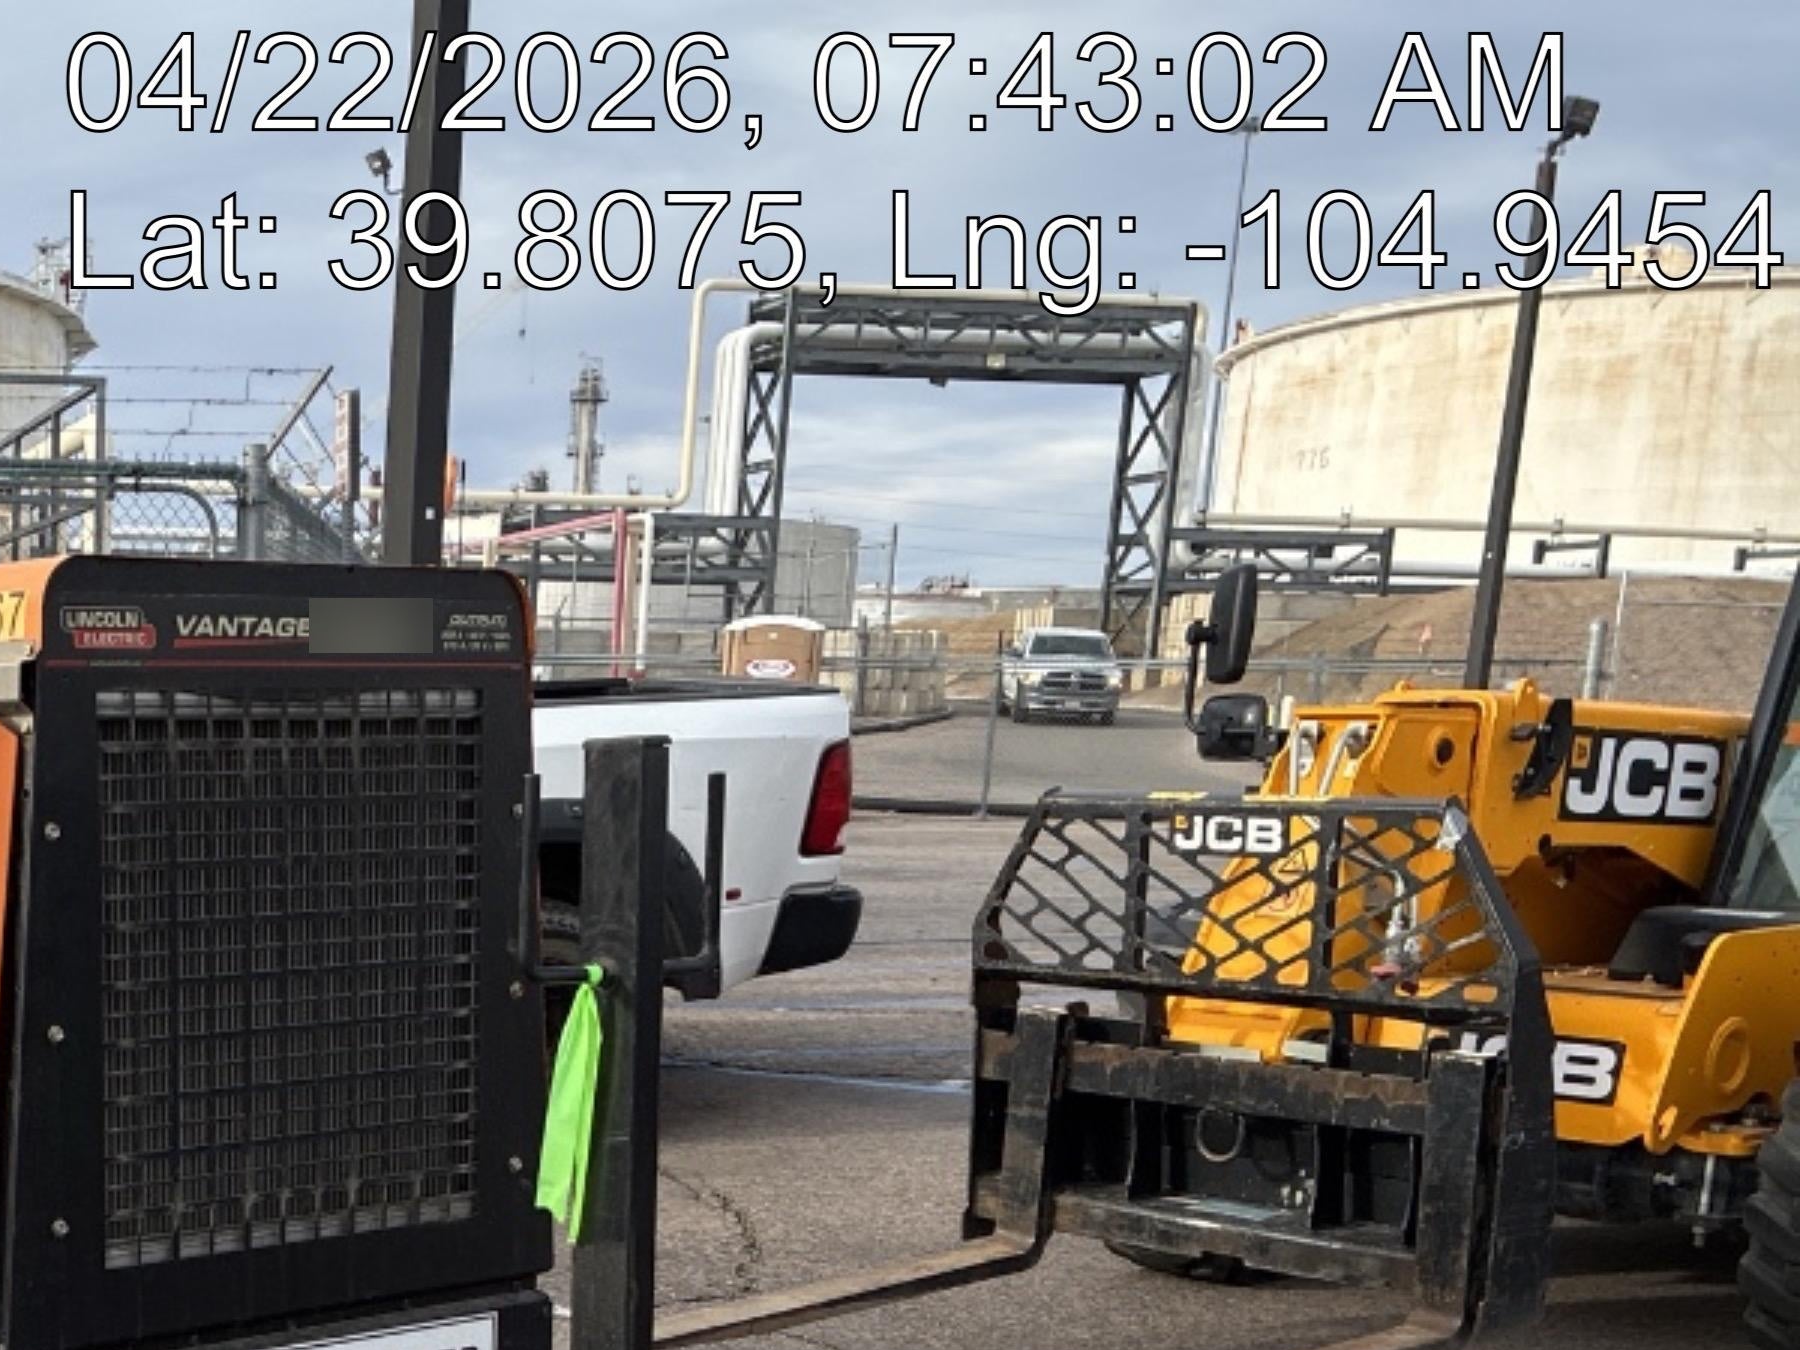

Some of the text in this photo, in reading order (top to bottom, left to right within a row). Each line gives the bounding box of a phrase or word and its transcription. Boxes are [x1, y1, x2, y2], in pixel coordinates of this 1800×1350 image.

[66, 611, 139, 628] LINCOLN
[82, 631, 146, 646] ELECTRIC
[1565, 737, 1720, 818] JCB
[1174, 816, 1282, 852] JCB
